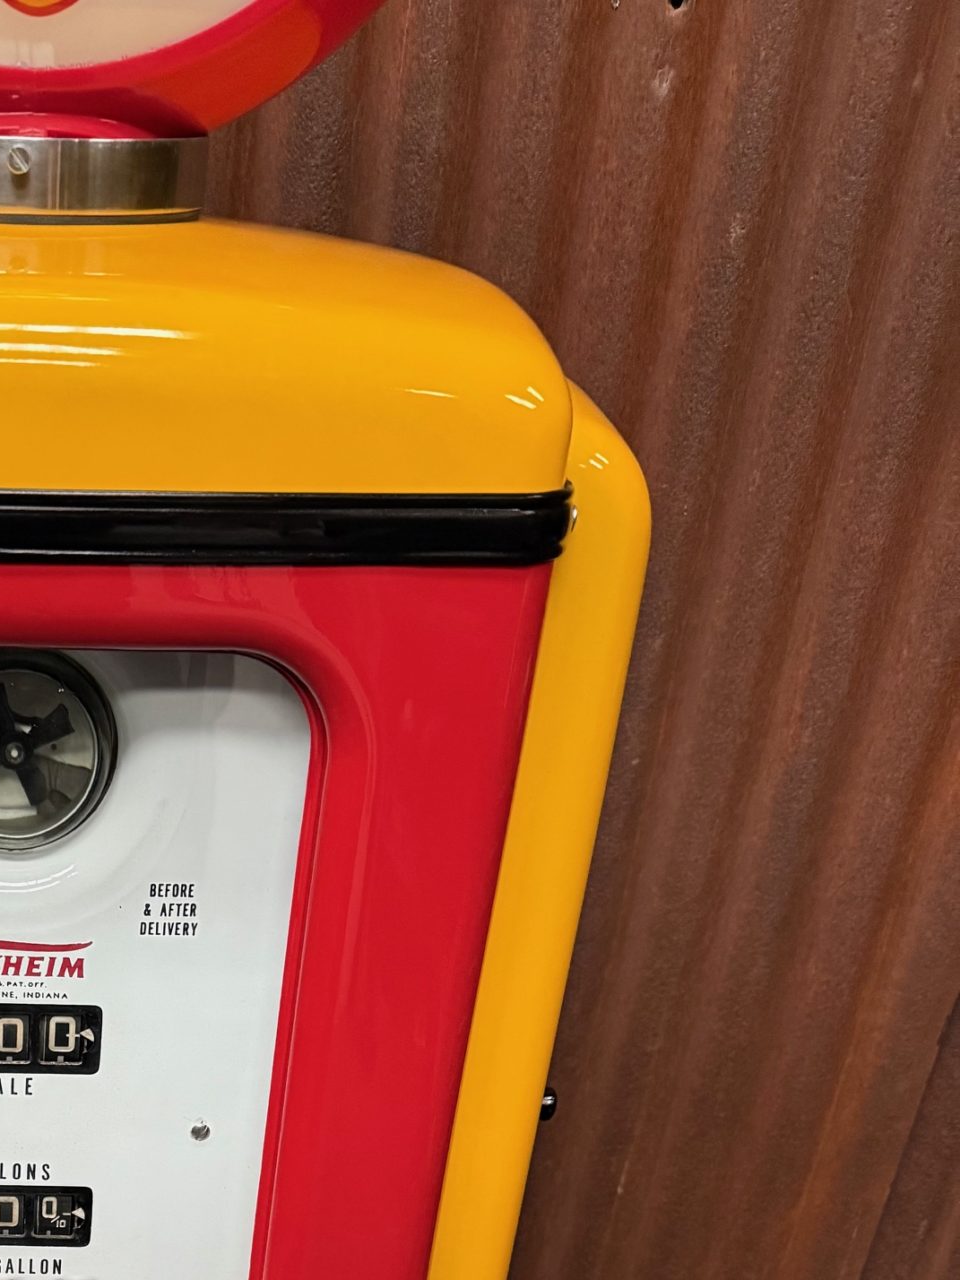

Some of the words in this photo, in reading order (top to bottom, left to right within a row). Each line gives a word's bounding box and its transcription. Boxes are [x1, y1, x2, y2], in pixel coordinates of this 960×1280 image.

[149, 882, 196, 899] BEFORE
[142, 903, 152, 917] &
[159, 902, 198, 918] AFTER
[139, 921, 199, 937] DELIVERY
[22, 991, 68, 1000] INDIANA
